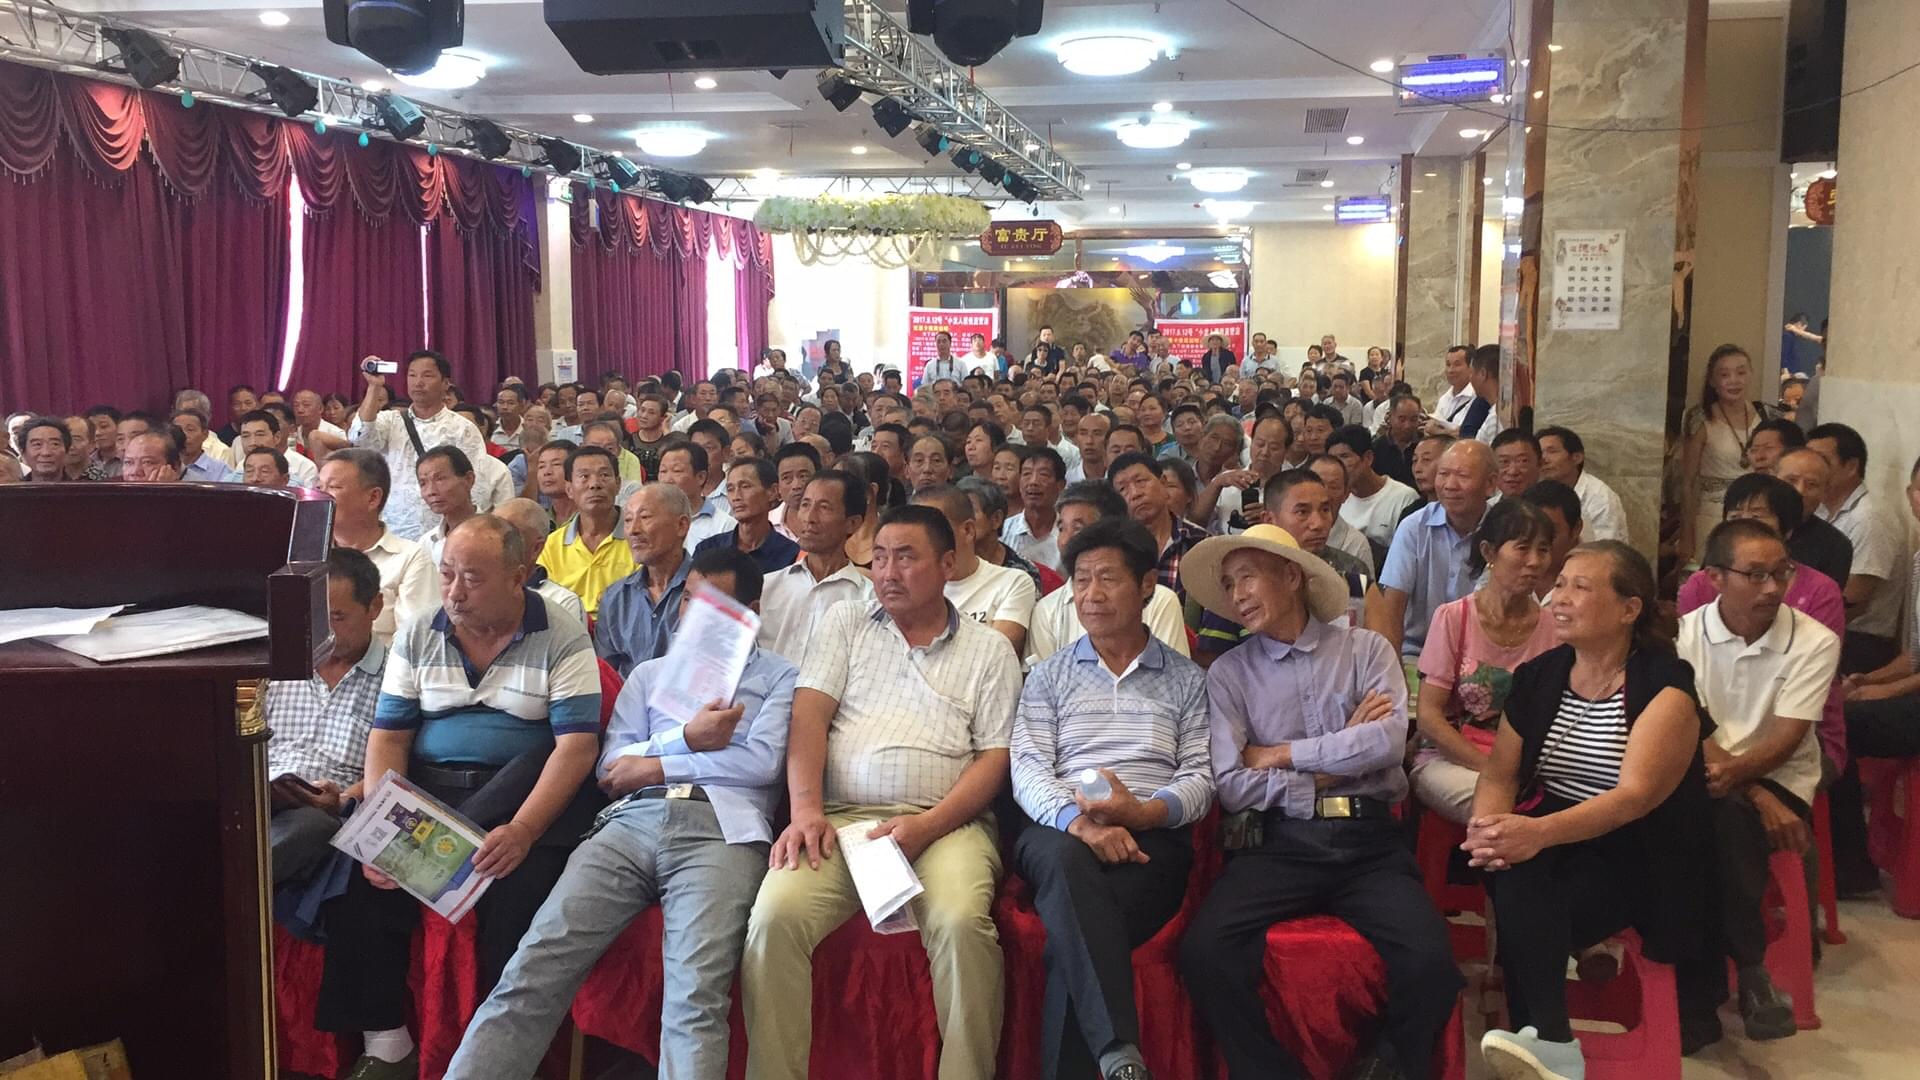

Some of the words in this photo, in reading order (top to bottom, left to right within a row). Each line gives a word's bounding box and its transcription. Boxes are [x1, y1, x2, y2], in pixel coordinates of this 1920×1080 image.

[995, 227, 1048, 243] 富贵厅
[964, 611, 987, 623] 12
